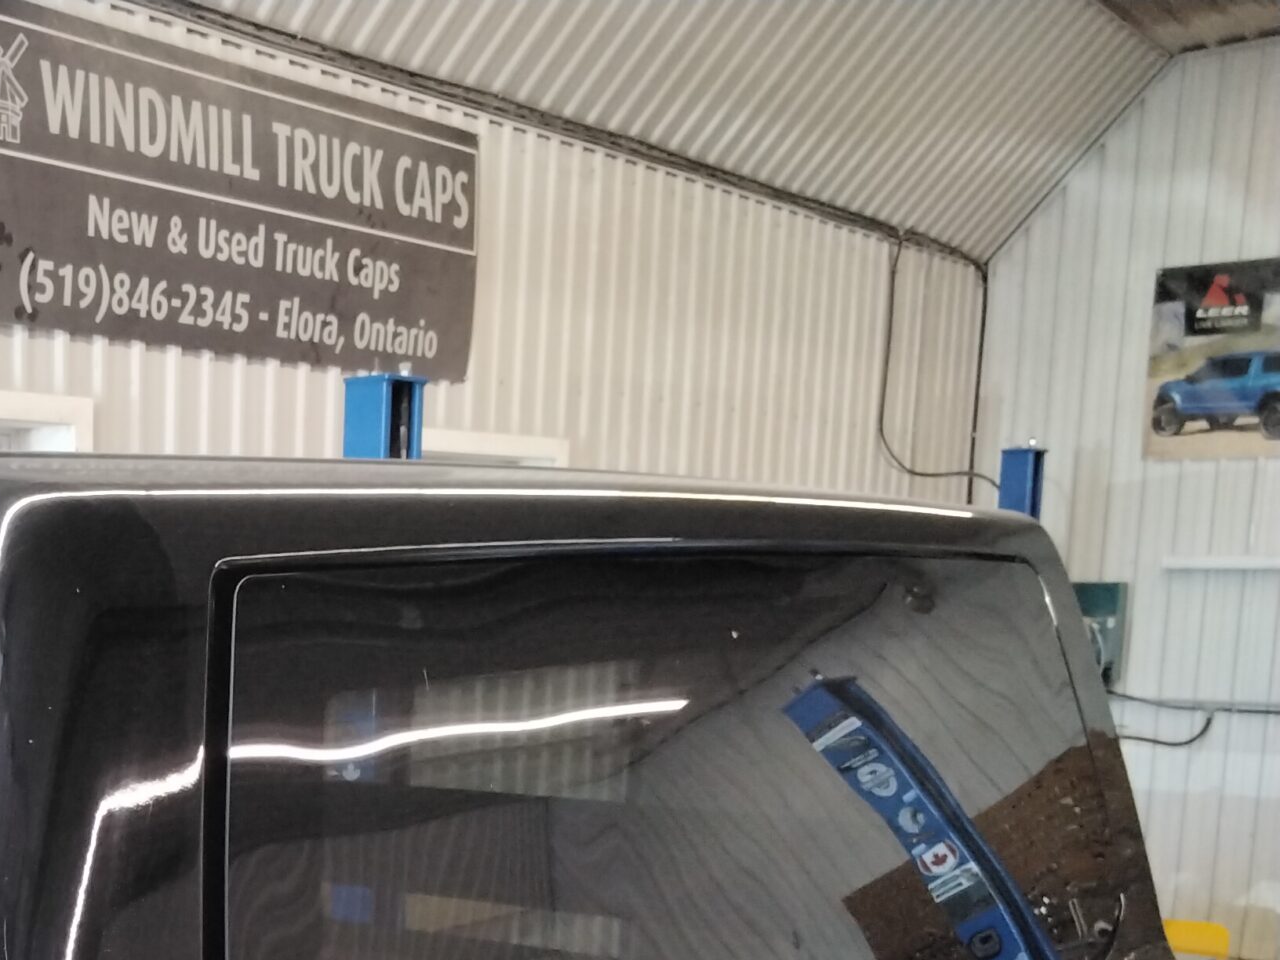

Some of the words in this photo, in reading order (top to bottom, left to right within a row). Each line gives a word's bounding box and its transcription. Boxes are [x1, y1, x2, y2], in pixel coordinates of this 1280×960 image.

[39, 59, 260, 181] WINDMILL
[272, 122, 384, 210] TRUCK
[395, 150, 470, 229] CAPS
[88, 194, 158, 248] New
[167, 219, 188, 255] &
[198, 219, 266, 269] Used
[274, 232, 339, 283] Truck
[347, 248, 401, 299] Caps
[18, 251, 250, 332] (519)846-2345
[277, 297, 345, 353] Elora,
[354, 312, 439, 359] Ontario
[1195, 305, 1249, 318] LEER
